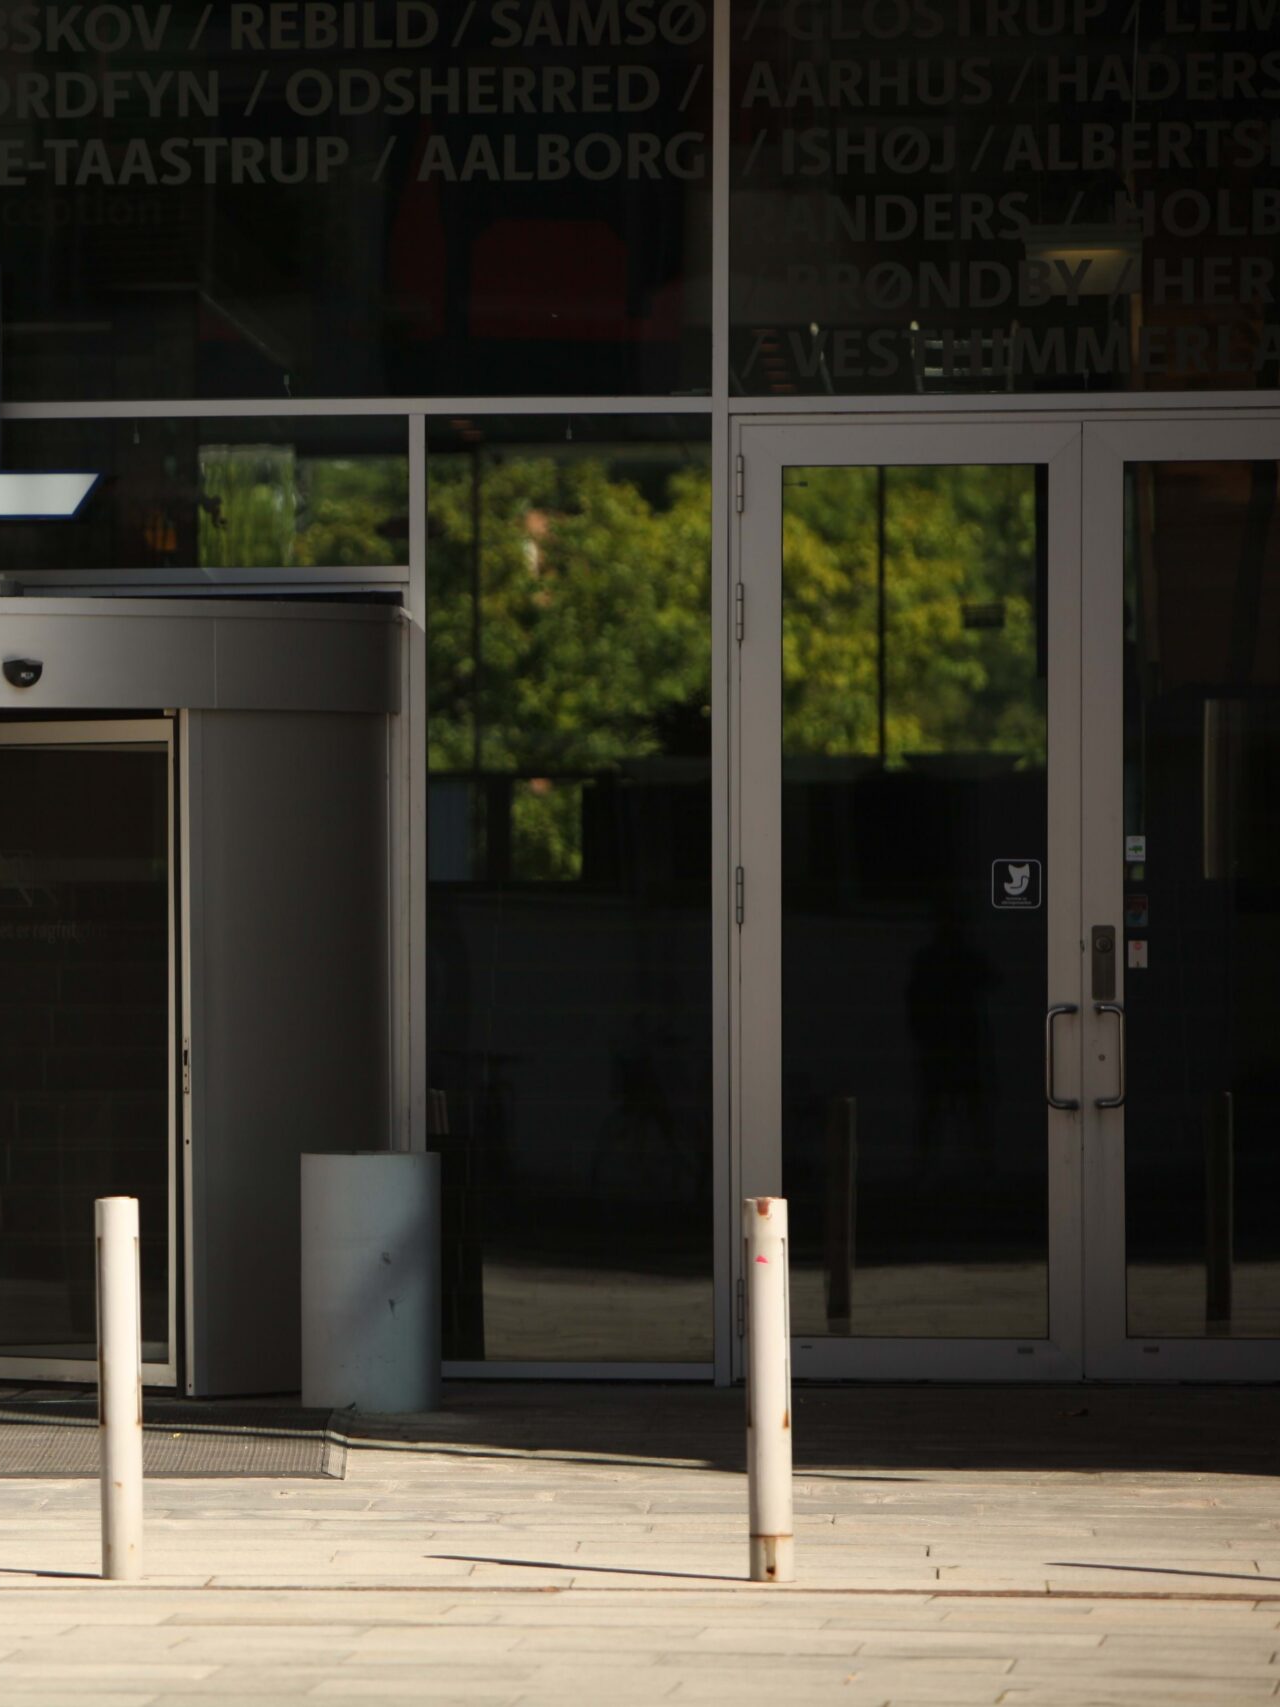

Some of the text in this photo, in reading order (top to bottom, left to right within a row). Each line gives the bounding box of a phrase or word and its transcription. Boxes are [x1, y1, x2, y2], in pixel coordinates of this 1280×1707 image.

[230, 1, 439, 50] REBILD
[489, 0, 707, 48] SAMSØ
[284, 65, 660, 117] ODSHERRED
[740, 56, 993, 109] AARHUS
[416, 131, 705, 182] AALBORG
[781, 125, 956, 175] ISHØJ
[786, 260, 1092, 309] BRØNDBY
[1153, 256, 1275, 305] HER
